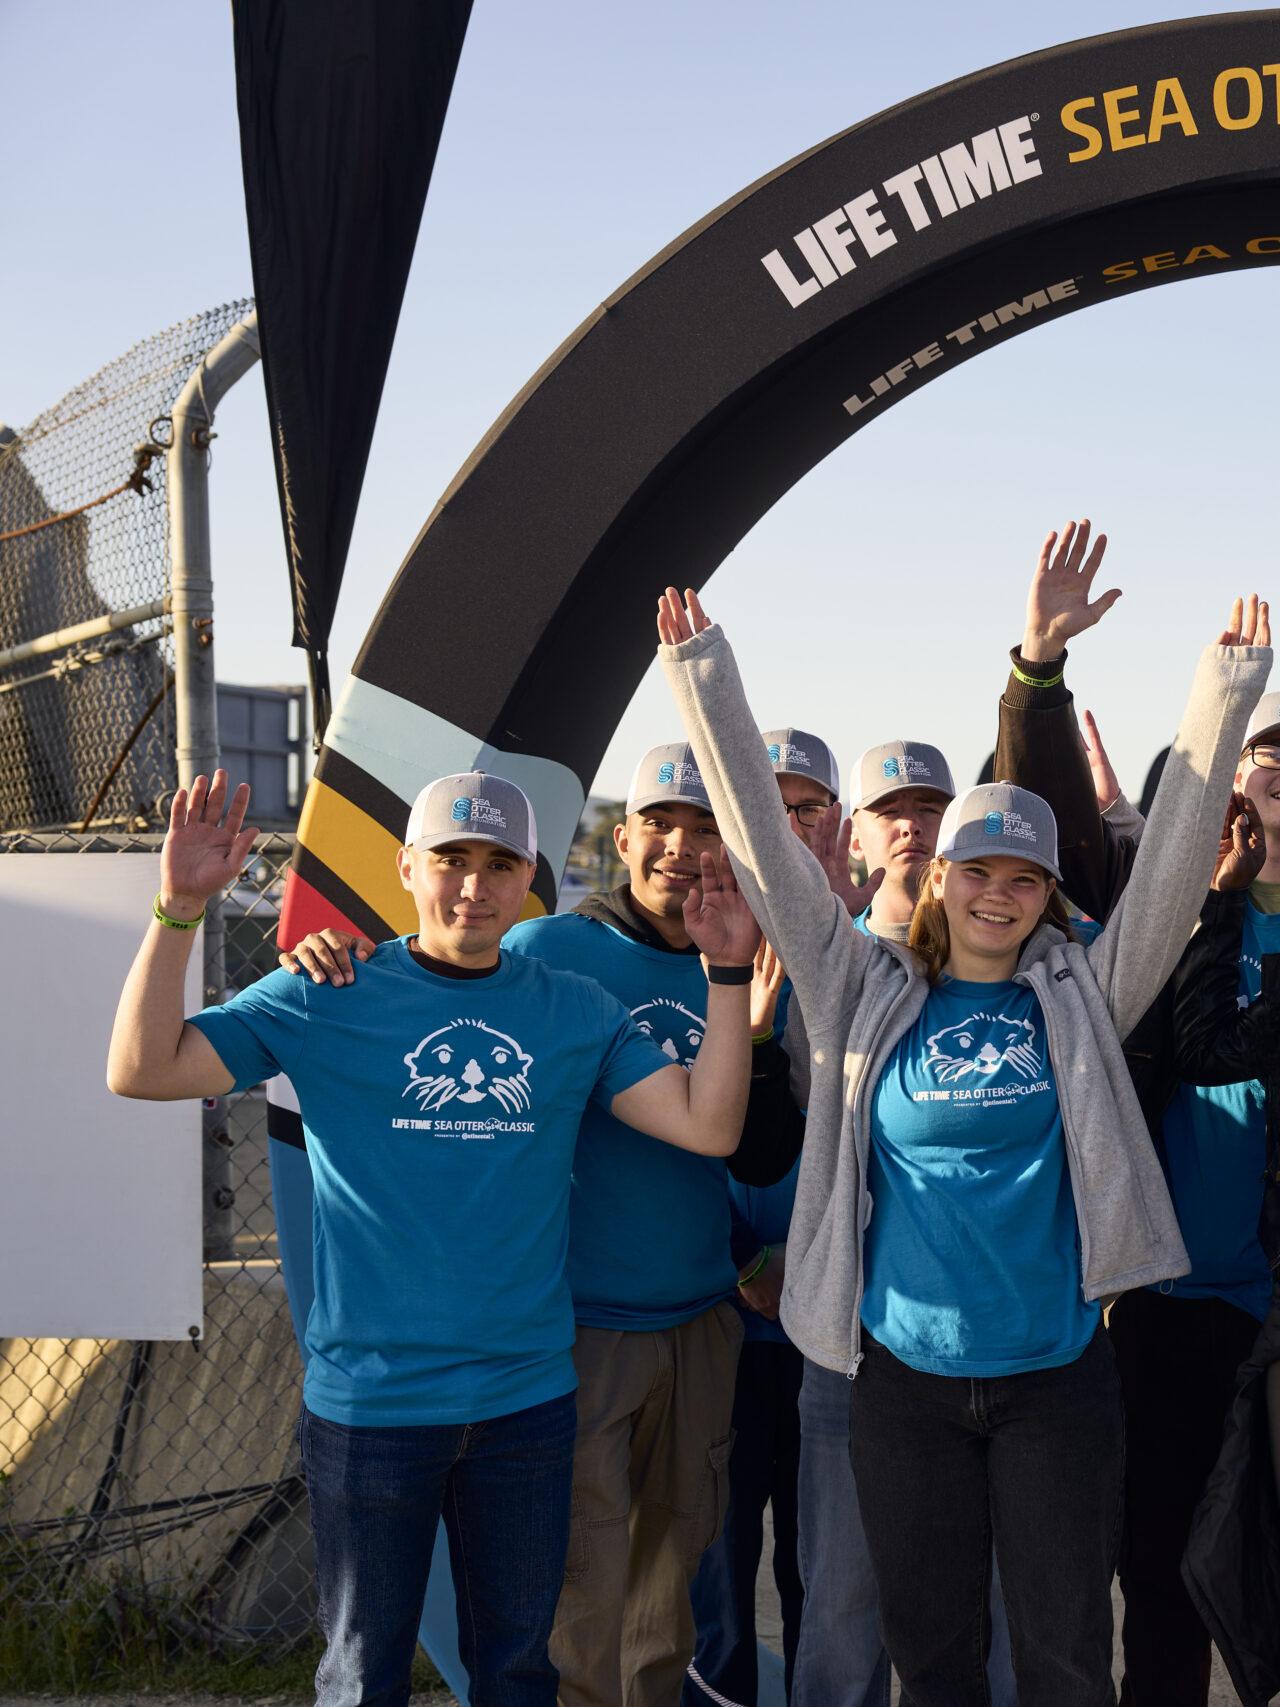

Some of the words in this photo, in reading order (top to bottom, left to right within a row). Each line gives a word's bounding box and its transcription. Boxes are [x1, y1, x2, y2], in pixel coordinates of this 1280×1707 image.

[761, 190, 898, 309] LIFE
[1060, 80, 1199, 163] SEA
[842, 342, 944, 416] LIFE
[946, 278, 1080, 345] TIME
[1101, 245, 1231, 284] SEA
[472, 798, 490, 807] SEA
[471, 804, 501, 816] OTTER
[1004, 812, 1021, 820] SEA
[470, 812, 507, 824] CLASSIC
[1003, 819, 1032, 830] OTTER
[1003, 825, 1036, 838] CLASSIC
[953, 1090, 972, 1100] SEA
[974, 1087, 1005, 1099] OTTER
[1019, 1080, 1051, 1095] CLASSIC
[392, 1118, 409, 1129] LIFE
[409, 1119, 432, 1130] TIME
[434, 1120, 453, 1130] SEA
[454, 1120, 485, 1131] OTTER
[499, 1121, 535, 1132] CLASSIC
